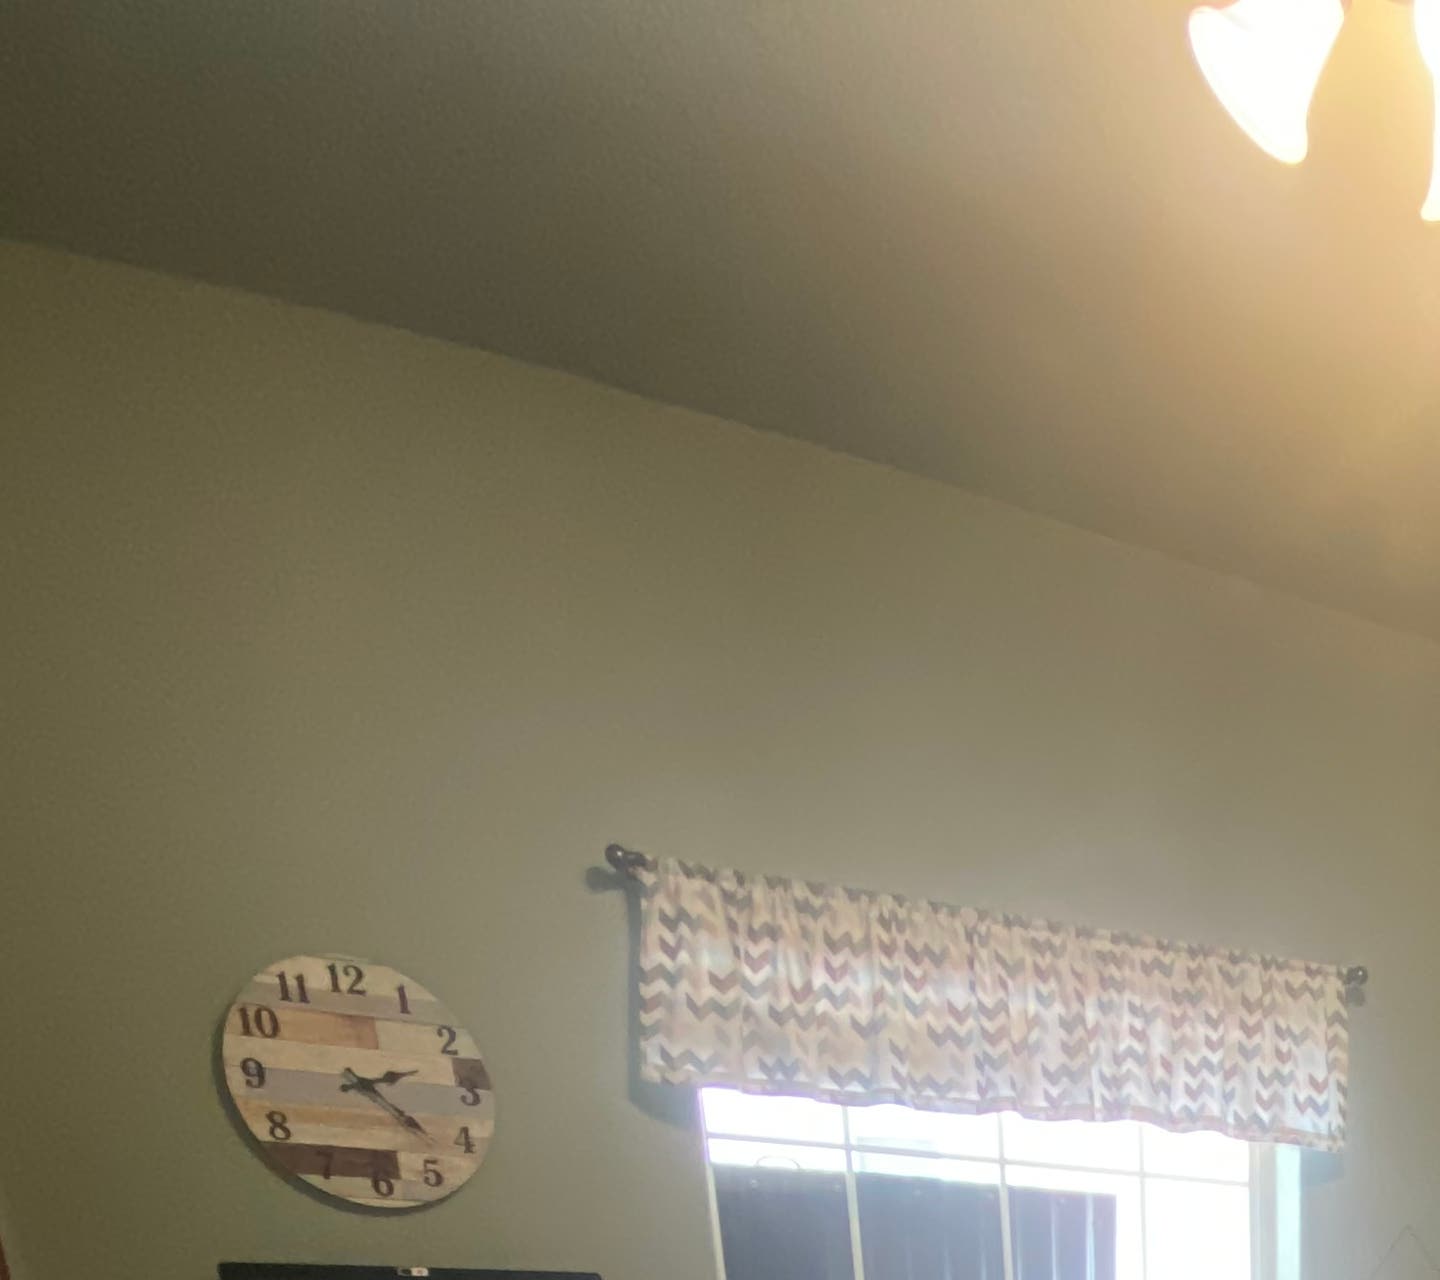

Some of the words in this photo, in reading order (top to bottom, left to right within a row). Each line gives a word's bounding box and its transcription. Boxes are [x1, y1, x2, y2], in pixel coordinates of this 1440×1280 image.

[276, 971, 310, 1004] 11
[327, 963, 366, 996] 12
[396, 984, 412, 1015] 1
[238, 1004, 280, 1038] 10
[437, 1025, 458, 1055] 2
[240, 1058, 266, 1088] 9
[266, 1111, 292, 1141] 8
[454, 1127, 475, 1154] 4
[314, 1151, 333, 1180] 7
[423, 1159, 444, 1187] 5
[371, 1166, 394, 1197] 6
